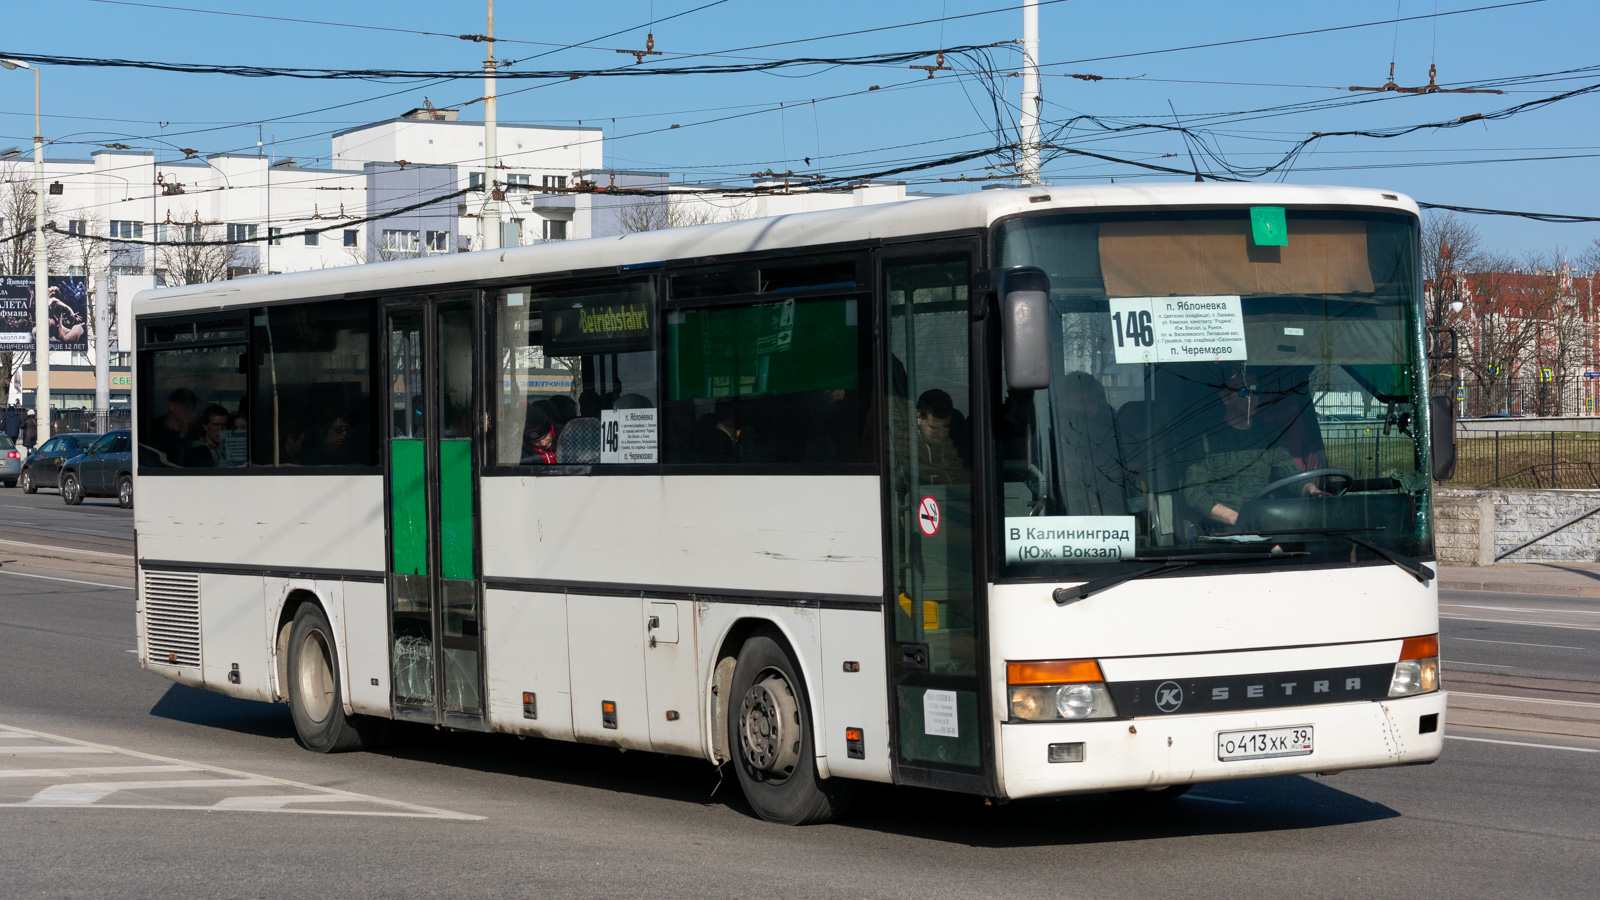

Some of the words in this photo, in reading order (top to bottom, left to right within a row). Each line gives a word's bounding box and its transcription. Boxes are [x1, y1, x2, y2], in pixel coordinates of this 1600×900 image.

[1167, 303, 1175, 311] п.
[1177, 302, 1227, 311] Яблоневка
[580, 304, 649, 333] Betriebsfahrt
[1112, 310, 1154, 347] 146
[1181, 346, 1232, 357] Черемхово
[630, 413, 653, 421] Яблоневка
[602, 420, 619, 453] 146
[629, 452, 653, 461] Черемхово
[1010, 528, 1020, 540] В
[1026, 527, 1130, 542] Калининград
[1018, 545, 1057, 562] (Юж.
[1062, 545, 1122, 561] Вокзал)
[1212, 677, 1361, 700] SETRA
[1292, 729, 1308, 744] 39
